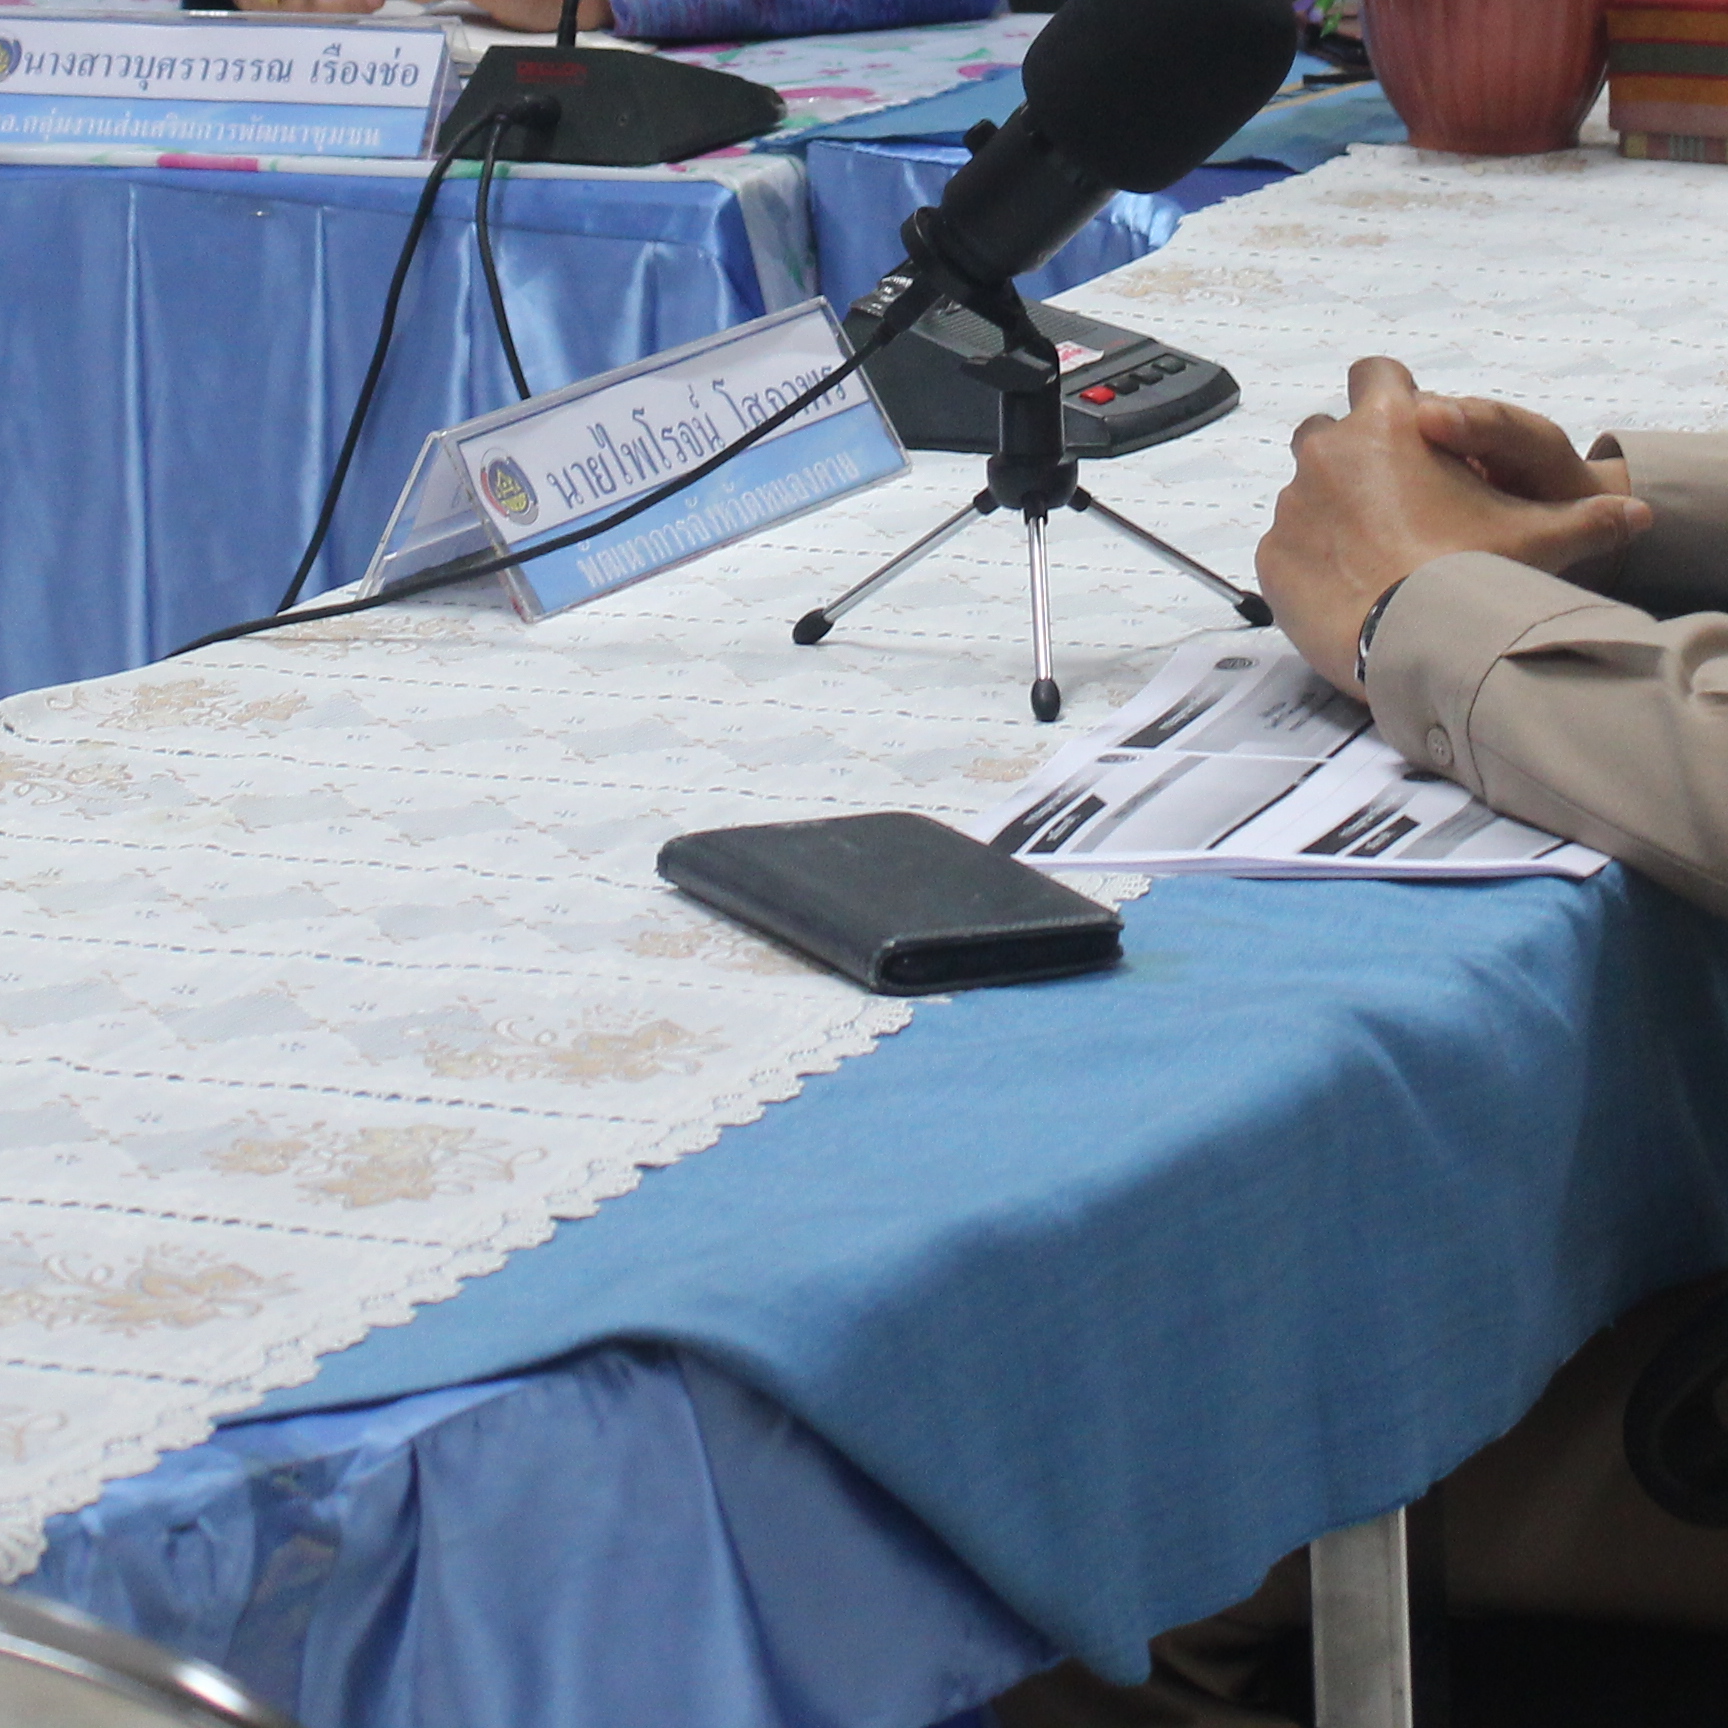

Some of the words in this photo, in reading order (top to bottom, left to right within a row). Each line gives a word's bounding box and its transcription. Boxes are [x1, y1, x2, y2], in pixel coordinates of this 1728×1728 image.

[23, 49, 292, 91] นางสาวบุศราวรรณ
[310, 42, 420, 87] เรืองช่อ
[546, 384, 726, 510] นายไพโรจน์
[576, 454, 859, 588] พัฒนาการจังหวัดหนองคาย
